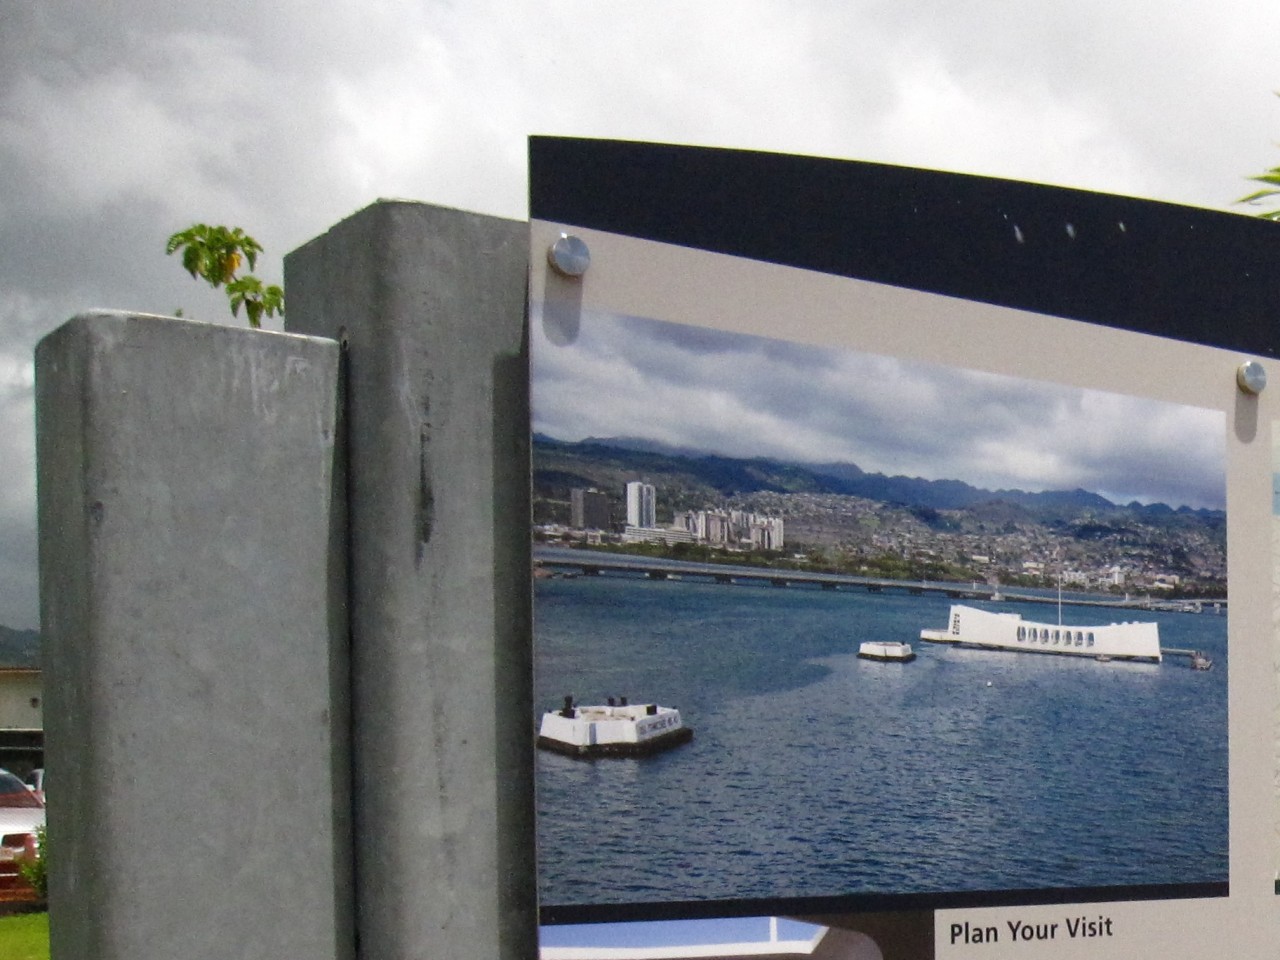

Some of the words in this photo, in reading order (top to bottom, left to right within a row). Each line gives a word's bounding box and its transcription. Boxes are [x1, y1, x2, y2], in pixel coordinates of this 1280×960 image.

[950, 922, 998, 944] Plan
[1006, 920, 1058, 941] Your
[1065, 916, 1113, 937] Visit
